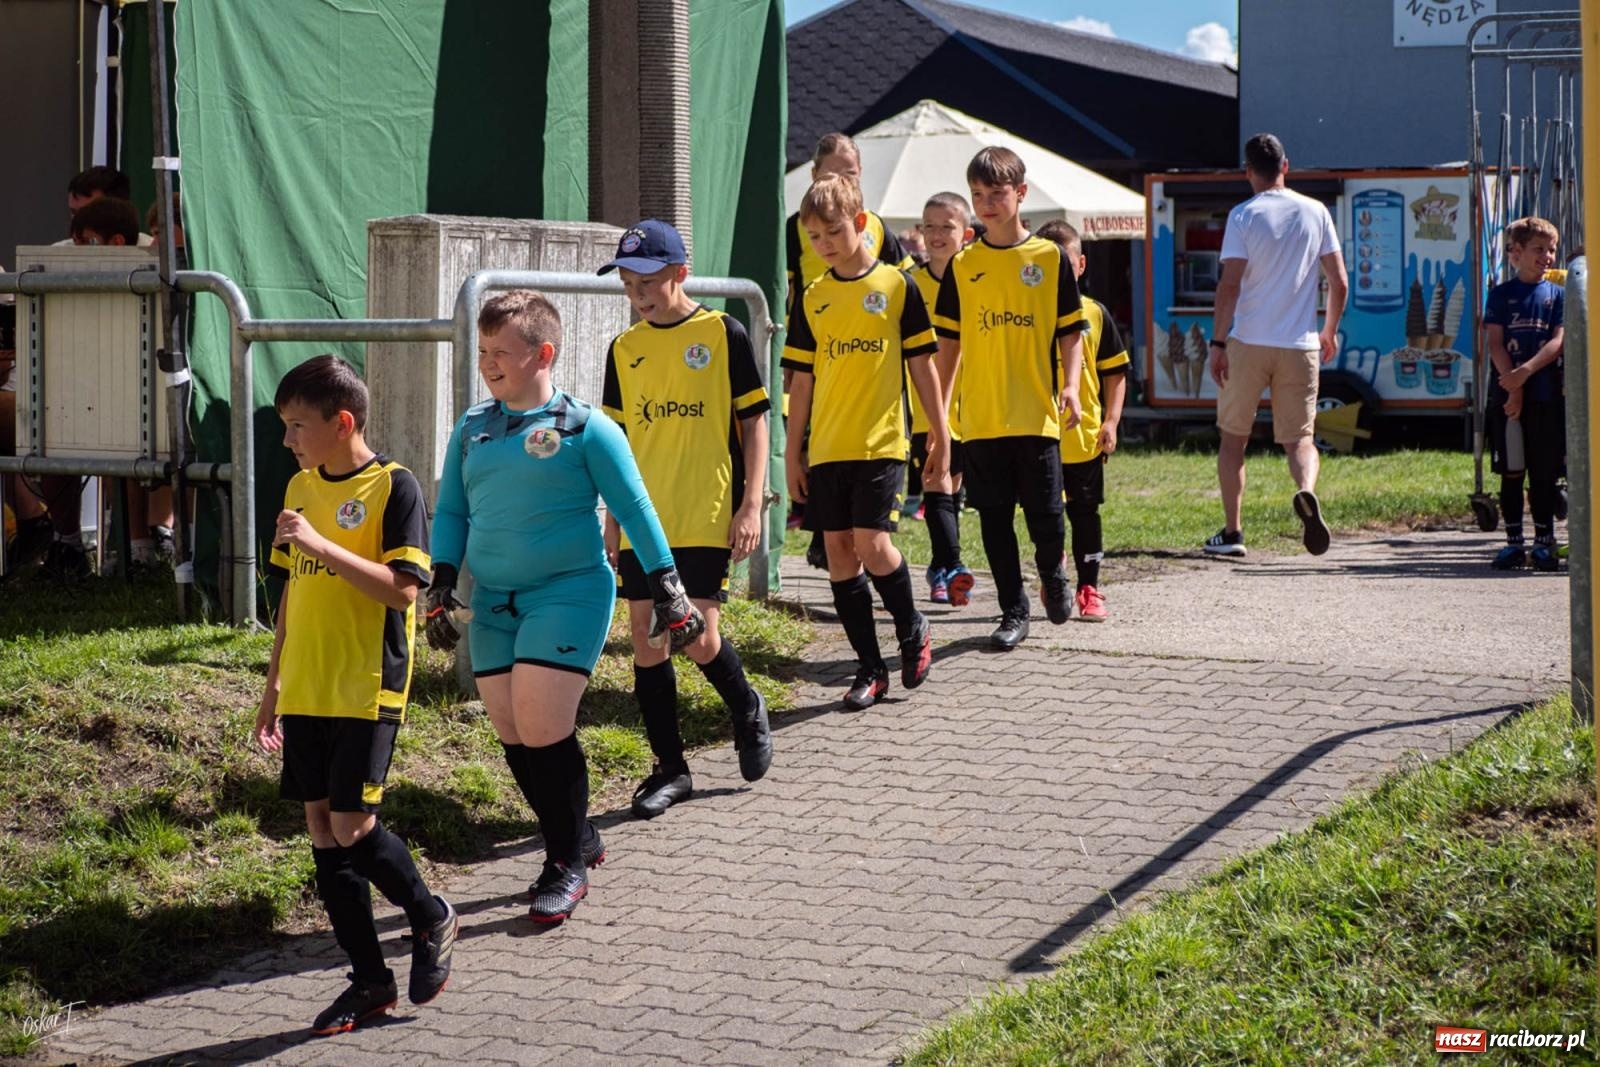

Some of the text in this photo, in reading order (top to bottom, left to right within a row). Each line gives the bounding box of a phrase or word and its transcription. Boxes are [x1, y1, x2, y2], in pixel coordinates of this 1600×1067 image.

[1405, 0, 1485, 27] NĘDZA
[992, 311, 1035, 328] InPost
[837, 338, 884, 355] InPost
[654, 401, 704, 418] InPost
